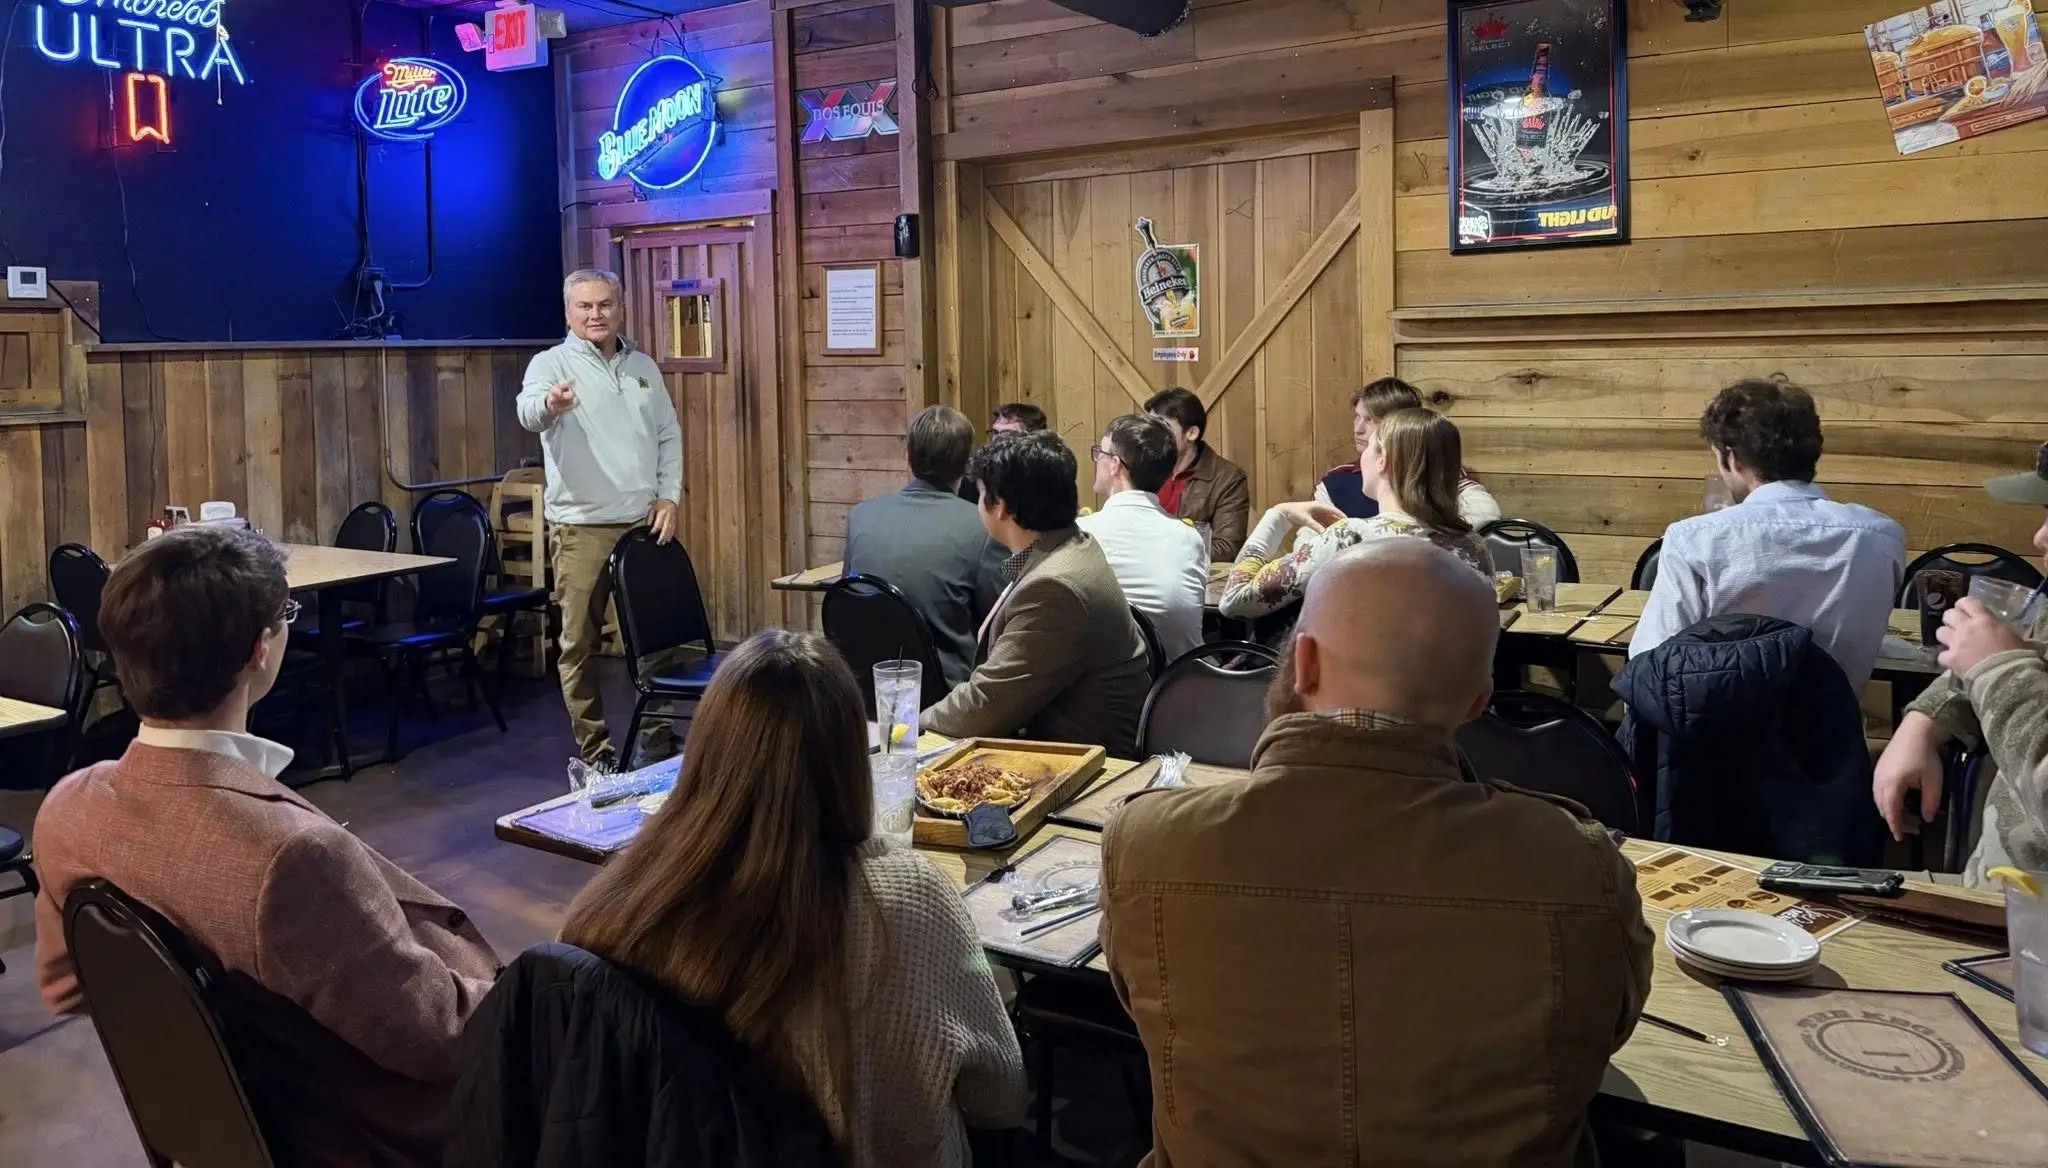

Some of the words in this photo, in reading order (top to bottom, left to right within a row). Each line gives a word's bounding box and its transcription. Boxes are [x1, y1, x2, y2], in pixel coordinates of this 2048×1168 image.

[36, 5, 245, 85] ULTRA
[494, 9, 527, 50] EXIT
[384, 63, 437, 84] Miller
[648, 83, 702, 142] MOON
[812, 106, 840, 121] DOS
[842, 99, 884, 118] EQUIS
[1154, 350, 1176, 359] Employees
